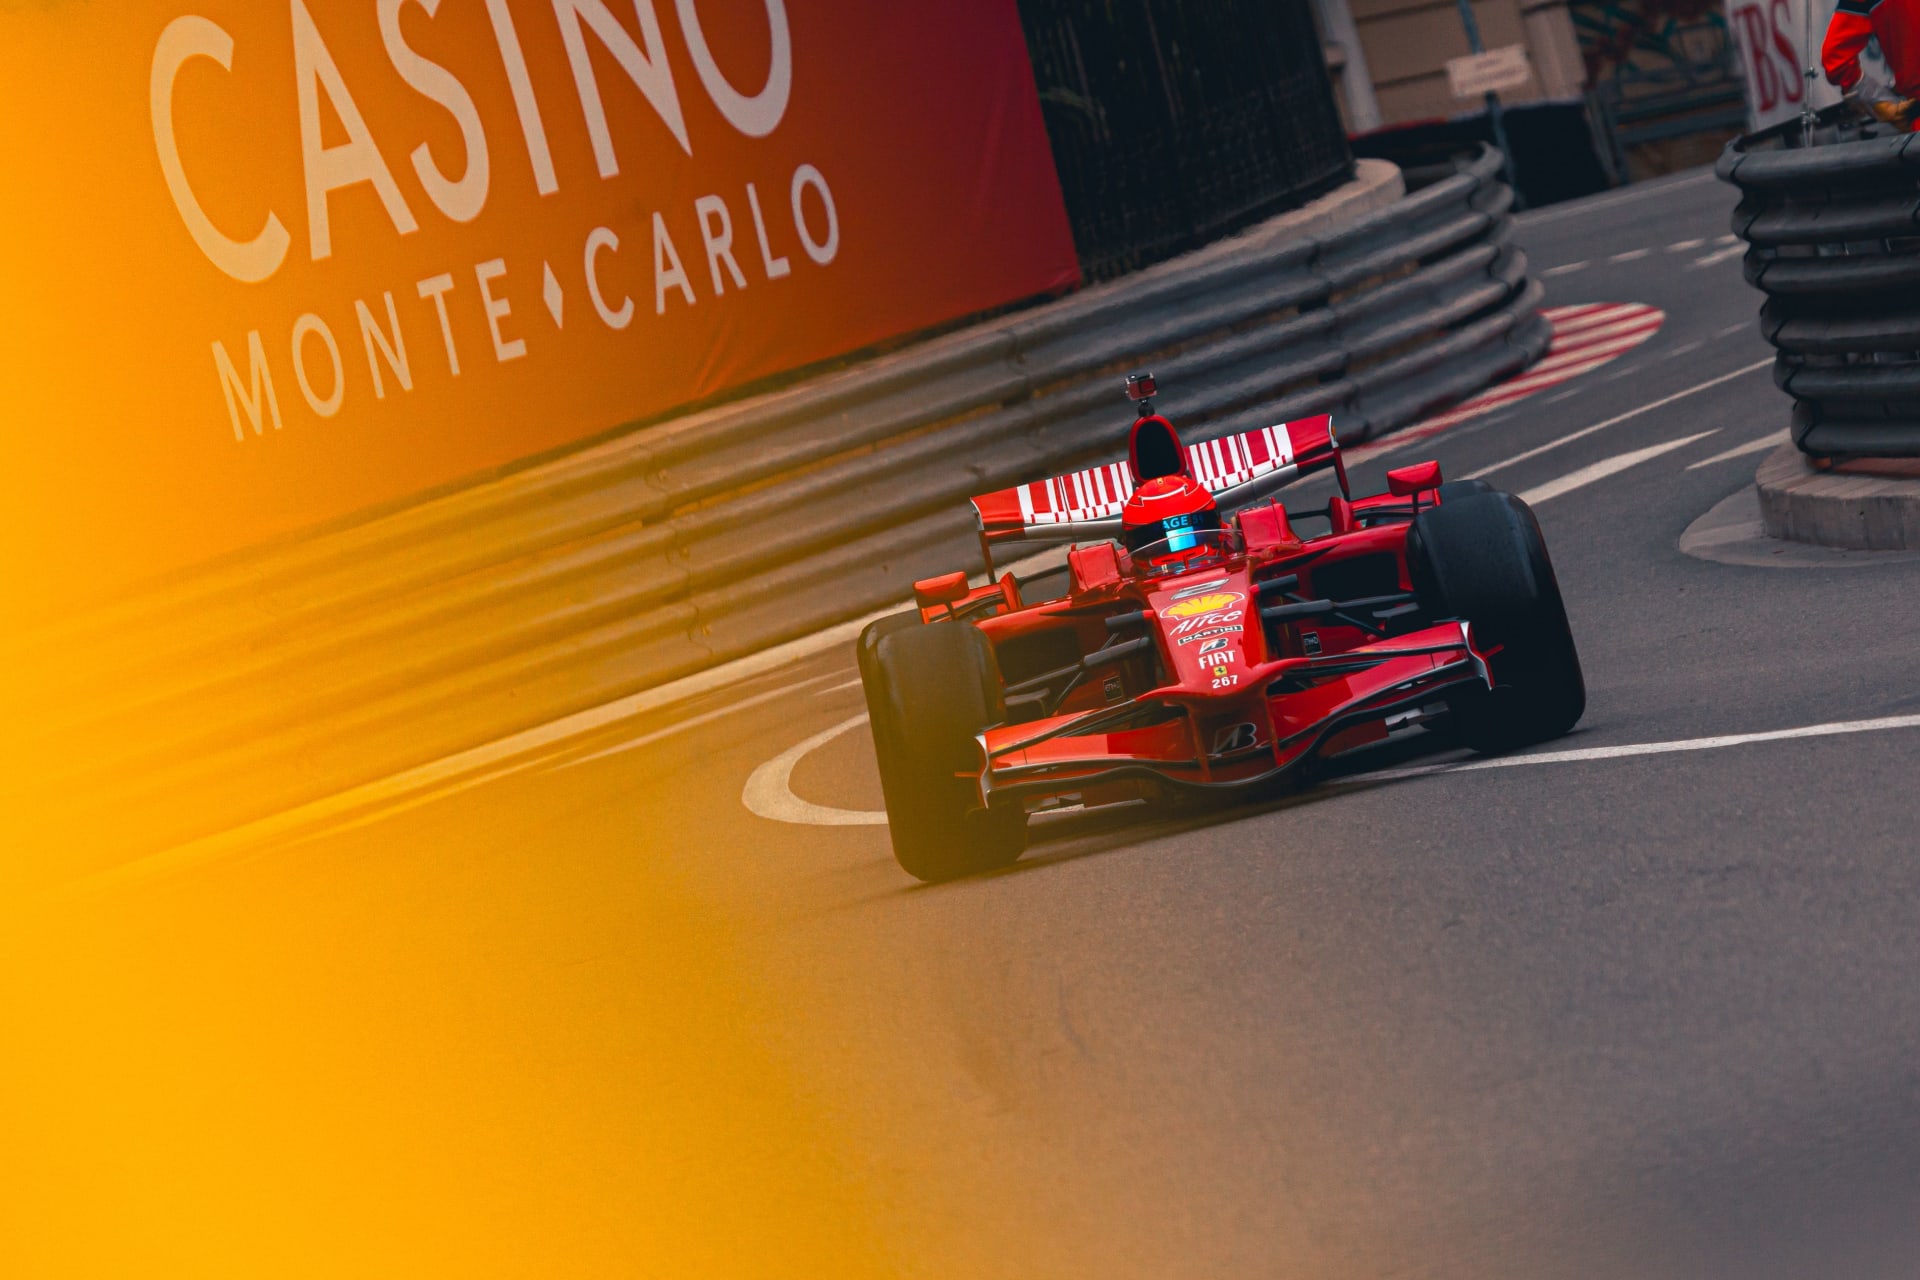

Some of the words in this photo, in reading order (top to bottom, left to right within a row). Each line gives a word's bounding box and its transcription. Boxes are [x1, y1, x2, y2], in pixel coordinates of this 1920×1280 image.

[150, 0, 793, 284] CASINO
[210, 257, 527, 443] MONTE
[584, 163, 840, 330] CARLO
[1182, 626, 1239, 643] MARTINI
[1198, 650, 1236, 670] FIAT
[1211, 674, 1238, 689] 267
